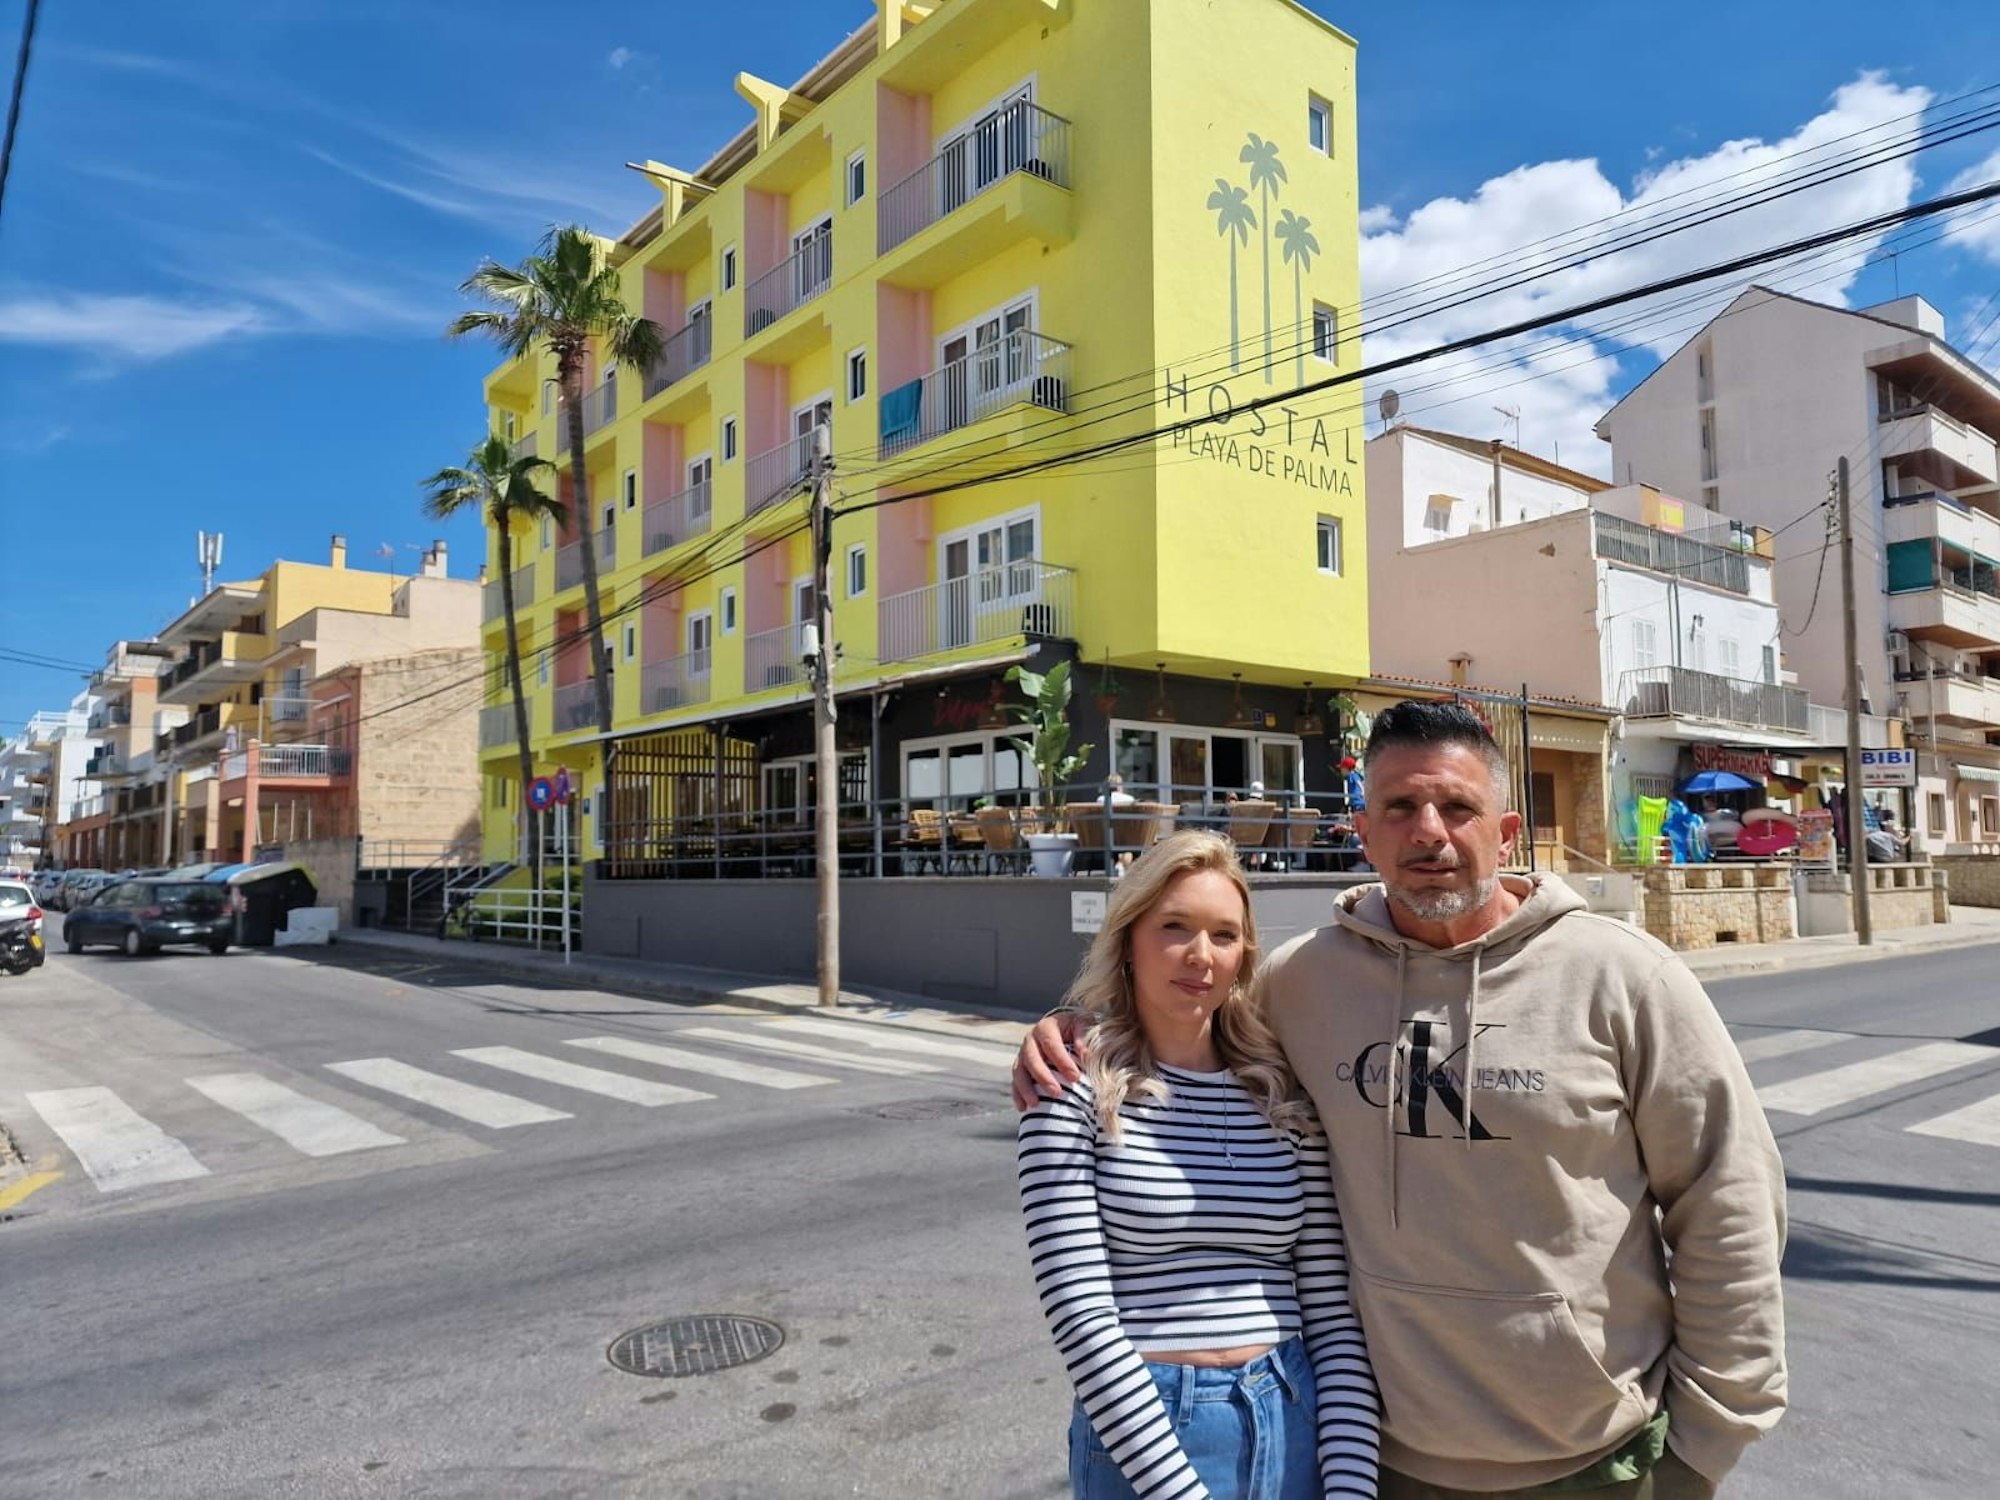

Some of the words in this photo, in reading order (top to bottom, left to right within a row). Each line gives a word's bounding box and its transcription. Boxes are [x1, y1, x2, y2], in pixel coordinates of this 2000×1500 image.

[1166, 368, 1358, 465] HOSTAL
[1172, 421, 1241, 468] PLAYA
[1249, 444, 1276, 477] DE
[1284, 454, 1352, 497] PALMA
[1861, 751, 1911, 764] BIBI
[1471, 1068, 1545, 1092] JEANS
